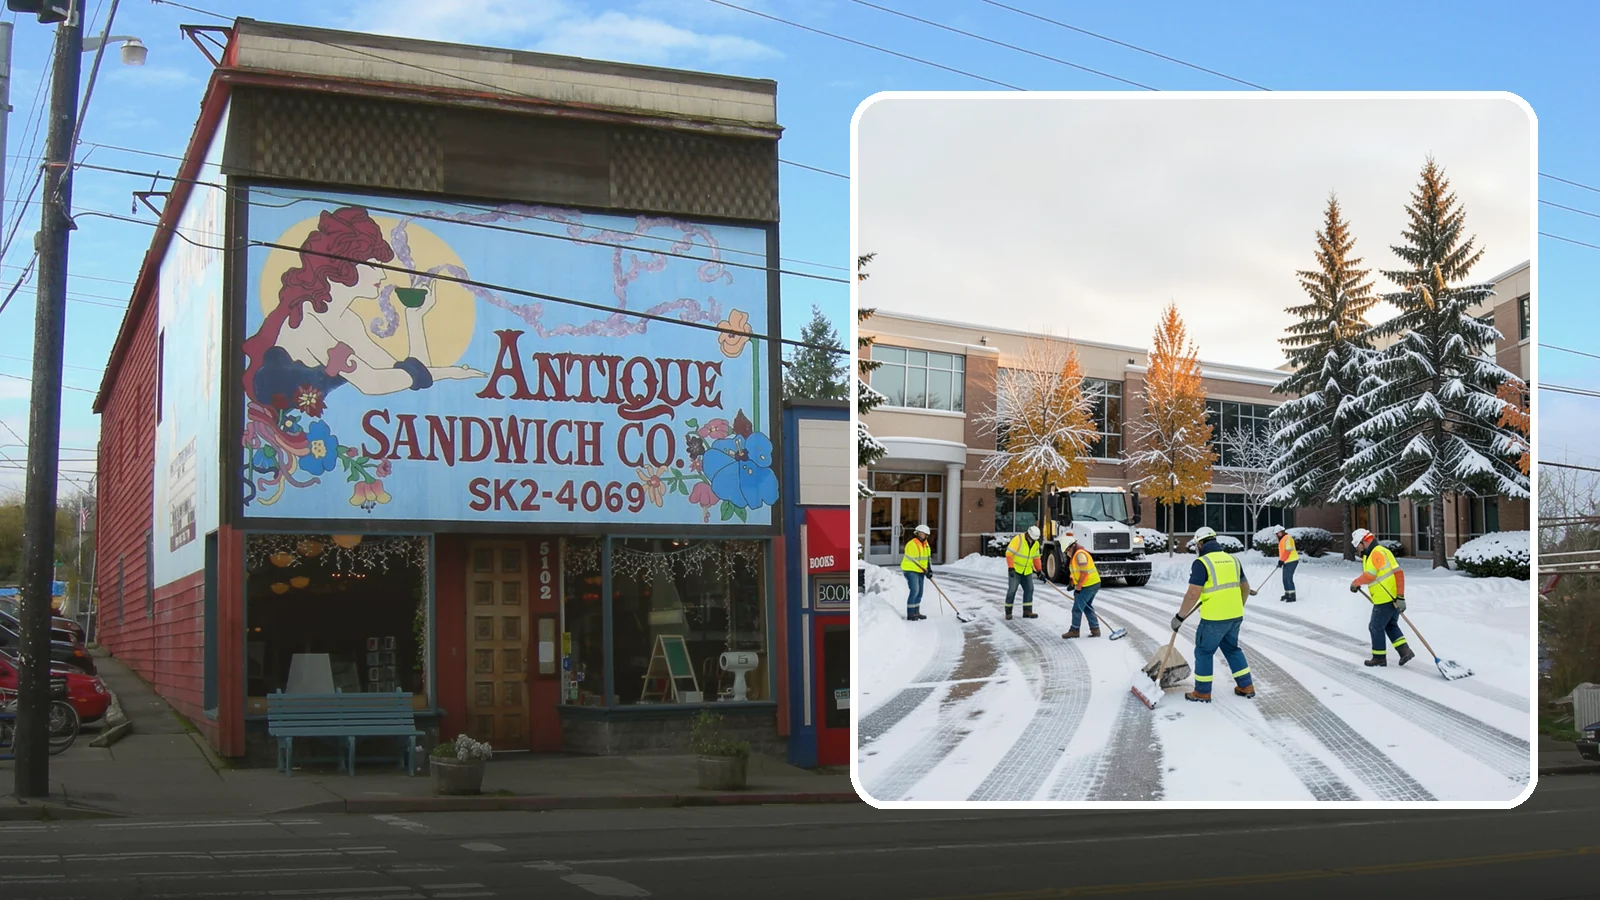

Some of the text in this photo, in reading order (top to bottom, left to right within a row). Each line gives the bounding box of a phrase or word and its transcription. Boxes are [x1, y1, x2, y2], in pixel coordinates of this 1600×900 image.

[476, 329, 723, 421] ANTIQUE
[361, 408, 685, 469] SANDWICH CO.
[468, 477, 646, 513] SK2-4069
[539, 541, 552, 600] 5102
[809, 555, 835, 569] BOOKS
